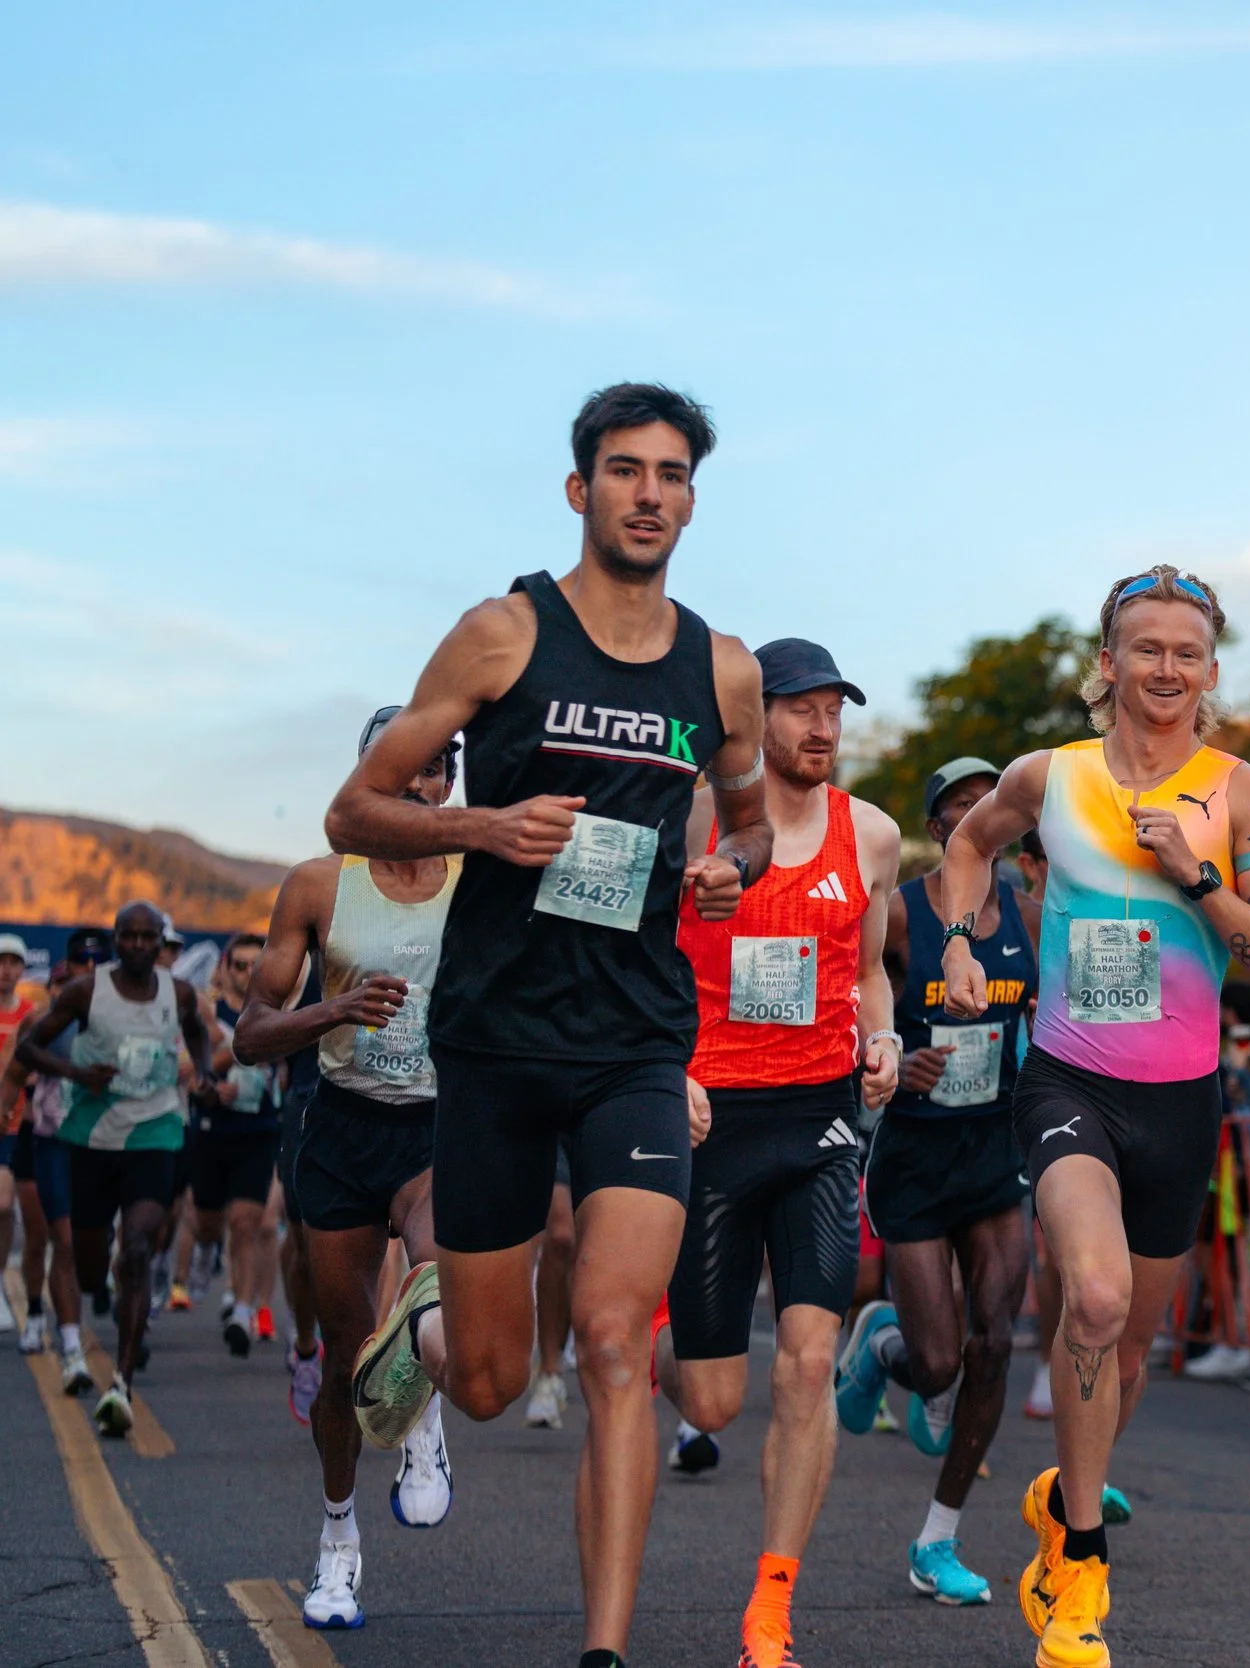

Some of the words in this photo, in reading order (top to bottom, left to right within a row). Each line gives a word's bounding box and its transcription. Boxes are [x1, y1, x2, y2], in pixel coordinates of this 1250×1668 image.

[588, 857, 614, 869] HALF
[571, 864, 626, 882] MARATHON
[555, 875, 632, 911] 24427
[393, 945, 431, 955] BANDIT
[1101, 955, 1124, 963] HALF
[765, 971, 786, 979] HALF
[1087, 965, 1139, 973] MARATHON
[752, 980, 799, 988] MARATHON
[1103, 976, 1122, 985] RORY
[1080, 988, 1149, 1009] 20050
[743, 1002, 805, 1021] 20051
[387, 1025, 408, 1035] HALF
[375, 1032, 421, 1044] MARATHON
[364, 1052, 424, 1073] 20052
[941, 1079, 991, 1095] 20053
